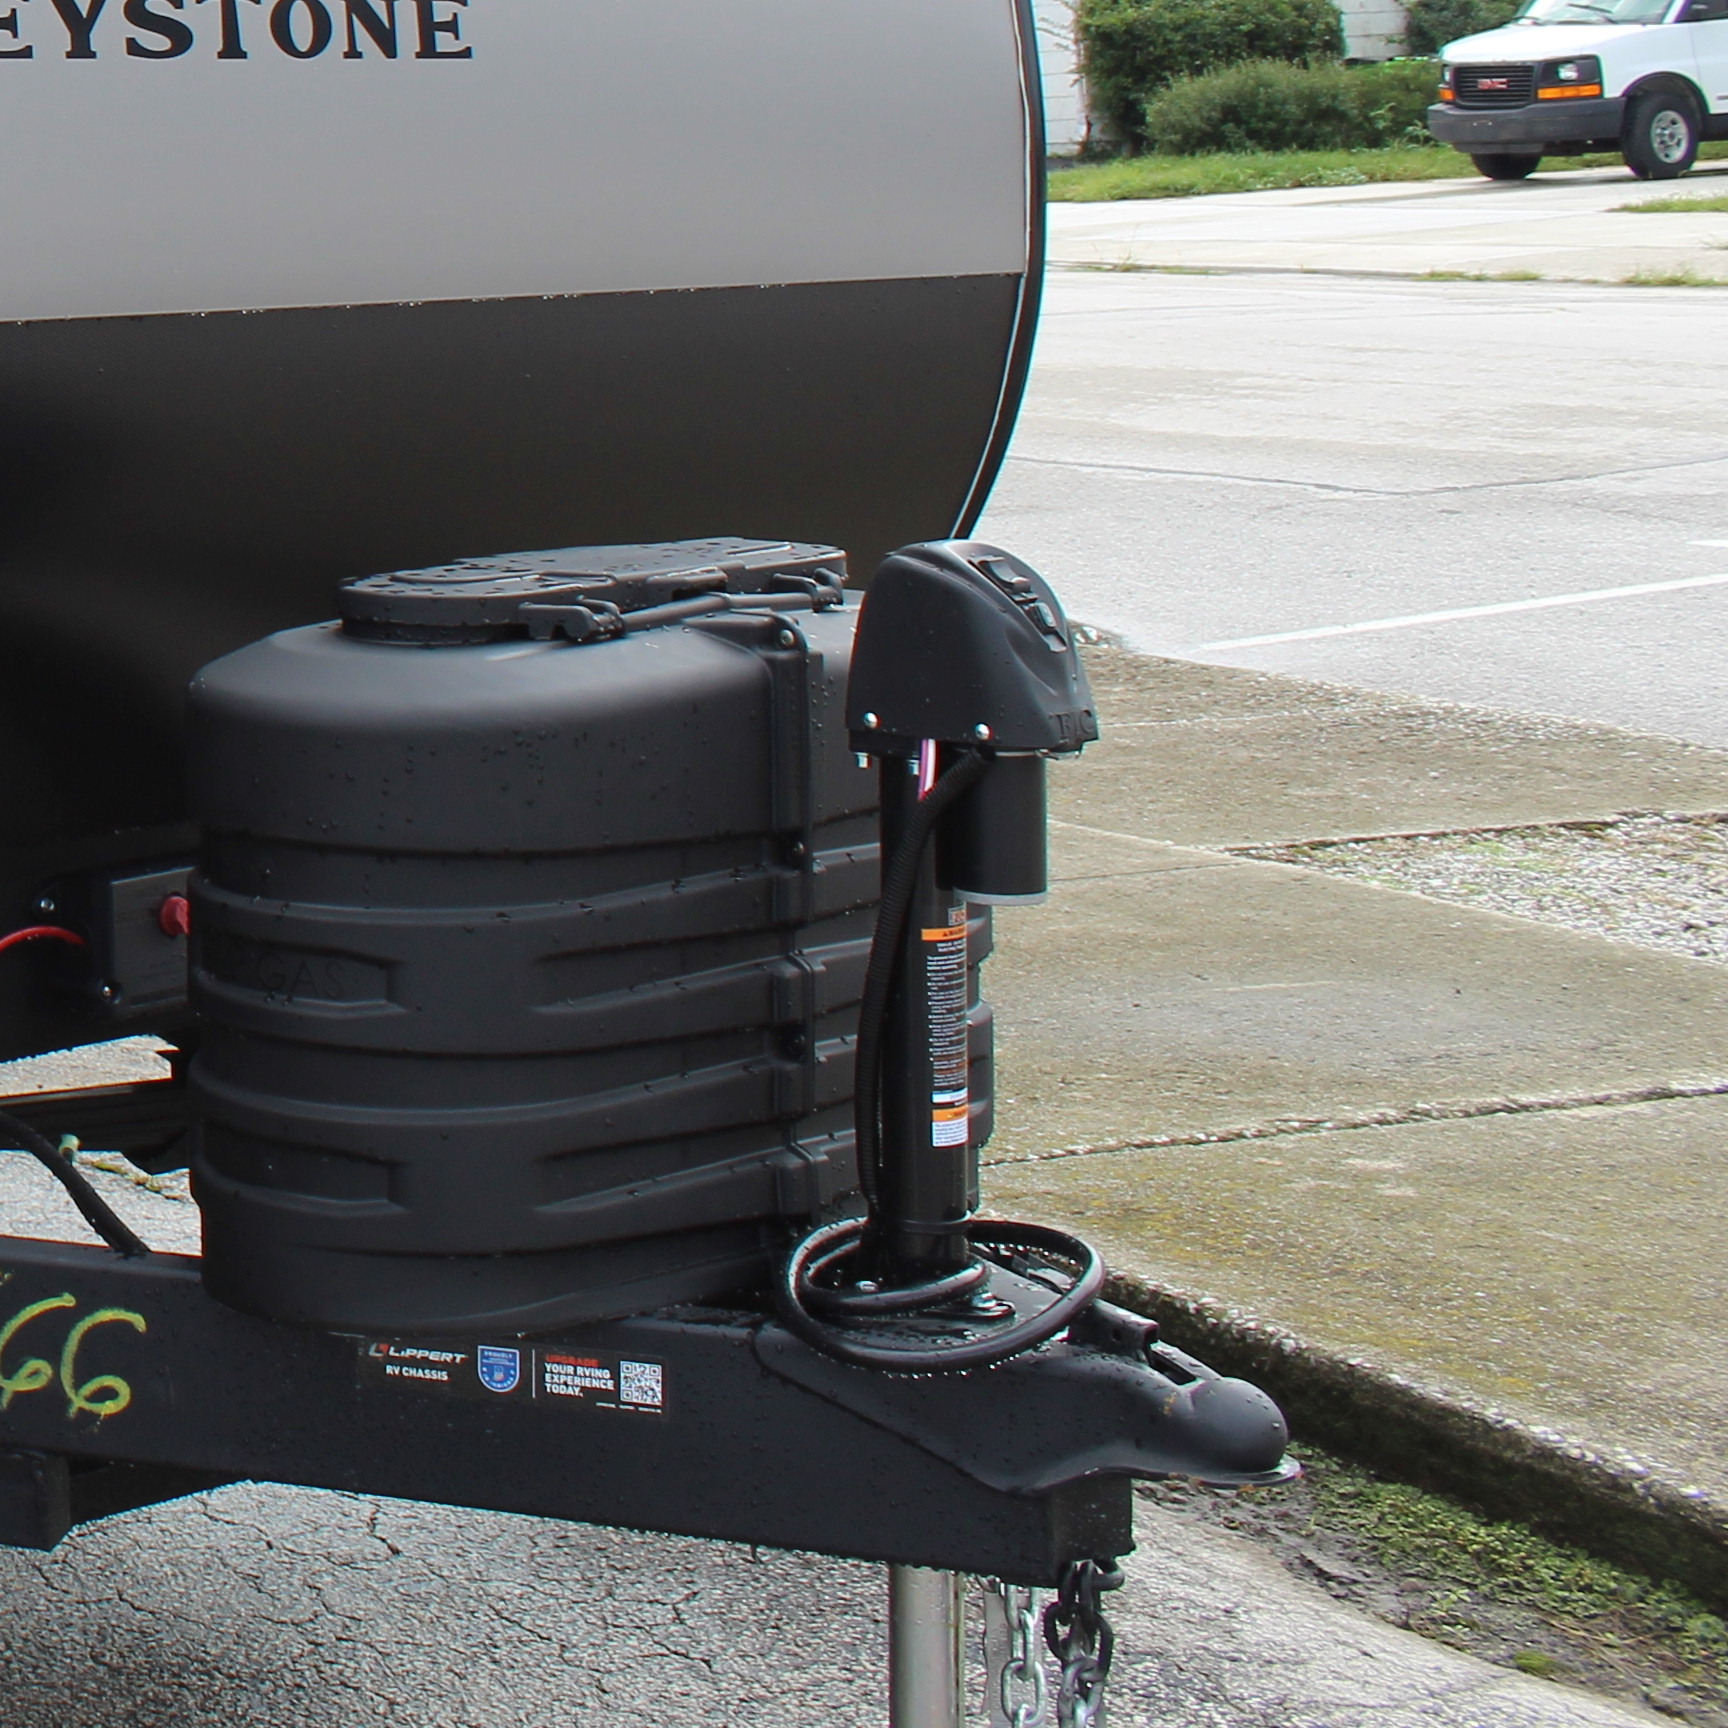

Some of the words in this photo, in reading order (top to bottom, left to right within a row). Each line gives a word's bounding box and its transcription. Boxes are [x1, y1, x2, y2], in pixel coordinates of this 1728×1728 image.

[385, 1364, 401, 1376] RV
[402, 1366, 449, 1381] CHASSIS
[544, 1362, 575, 1376] YOUR
[576, 1366, 611, 1380] RVING
[544, 1372, 616, 1391] EXPERIENCE
[544, 1382, 584, 1398] TODAY.
